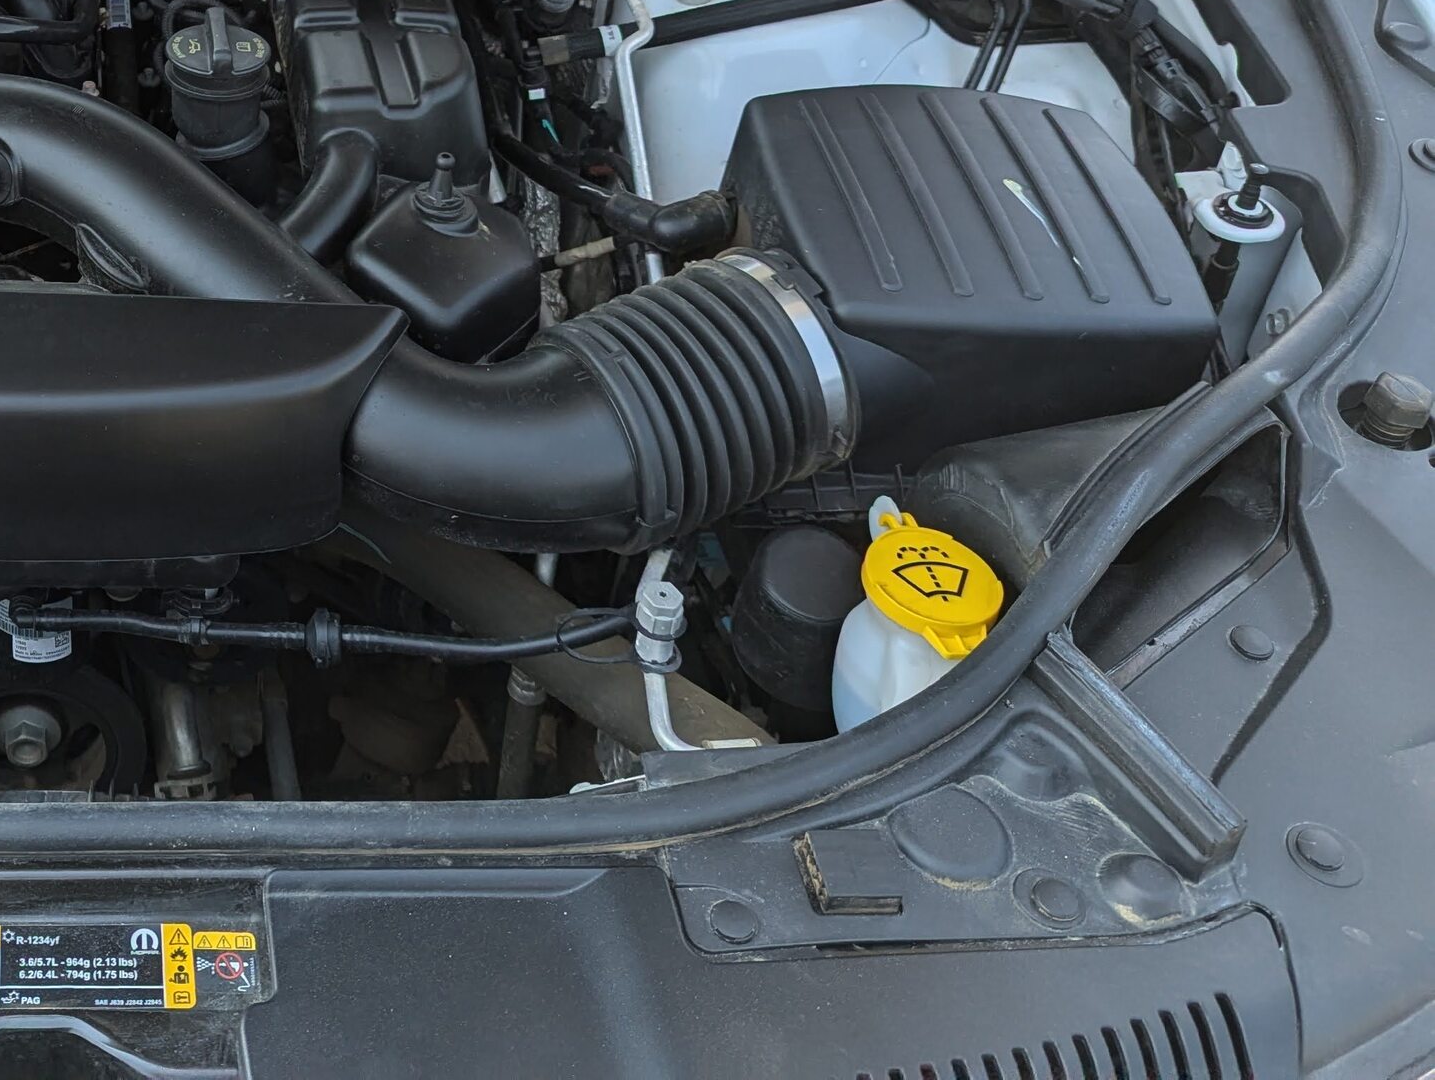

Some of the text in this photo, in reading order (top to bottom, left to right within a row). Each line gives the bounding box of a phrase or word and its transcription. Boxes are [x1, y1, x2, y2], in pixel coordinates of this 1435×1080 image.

[16, 935, 60, 946] R-1234yf
[19, 957, 59, 967] 3.6/5.7L
[66, 957, 90, 968] 964g
[93, 957, 117, 968] (2.13
[119, 957, 137, 968] lbs)
[19, 970, 59, 980] 6.2/6.4L
[67, 970, 91, 981] 794g
[93, 970, 117, 980] (1.75
[119, 970, 138, 980] lbs)
[21, 996, 41, 1005] PAG
